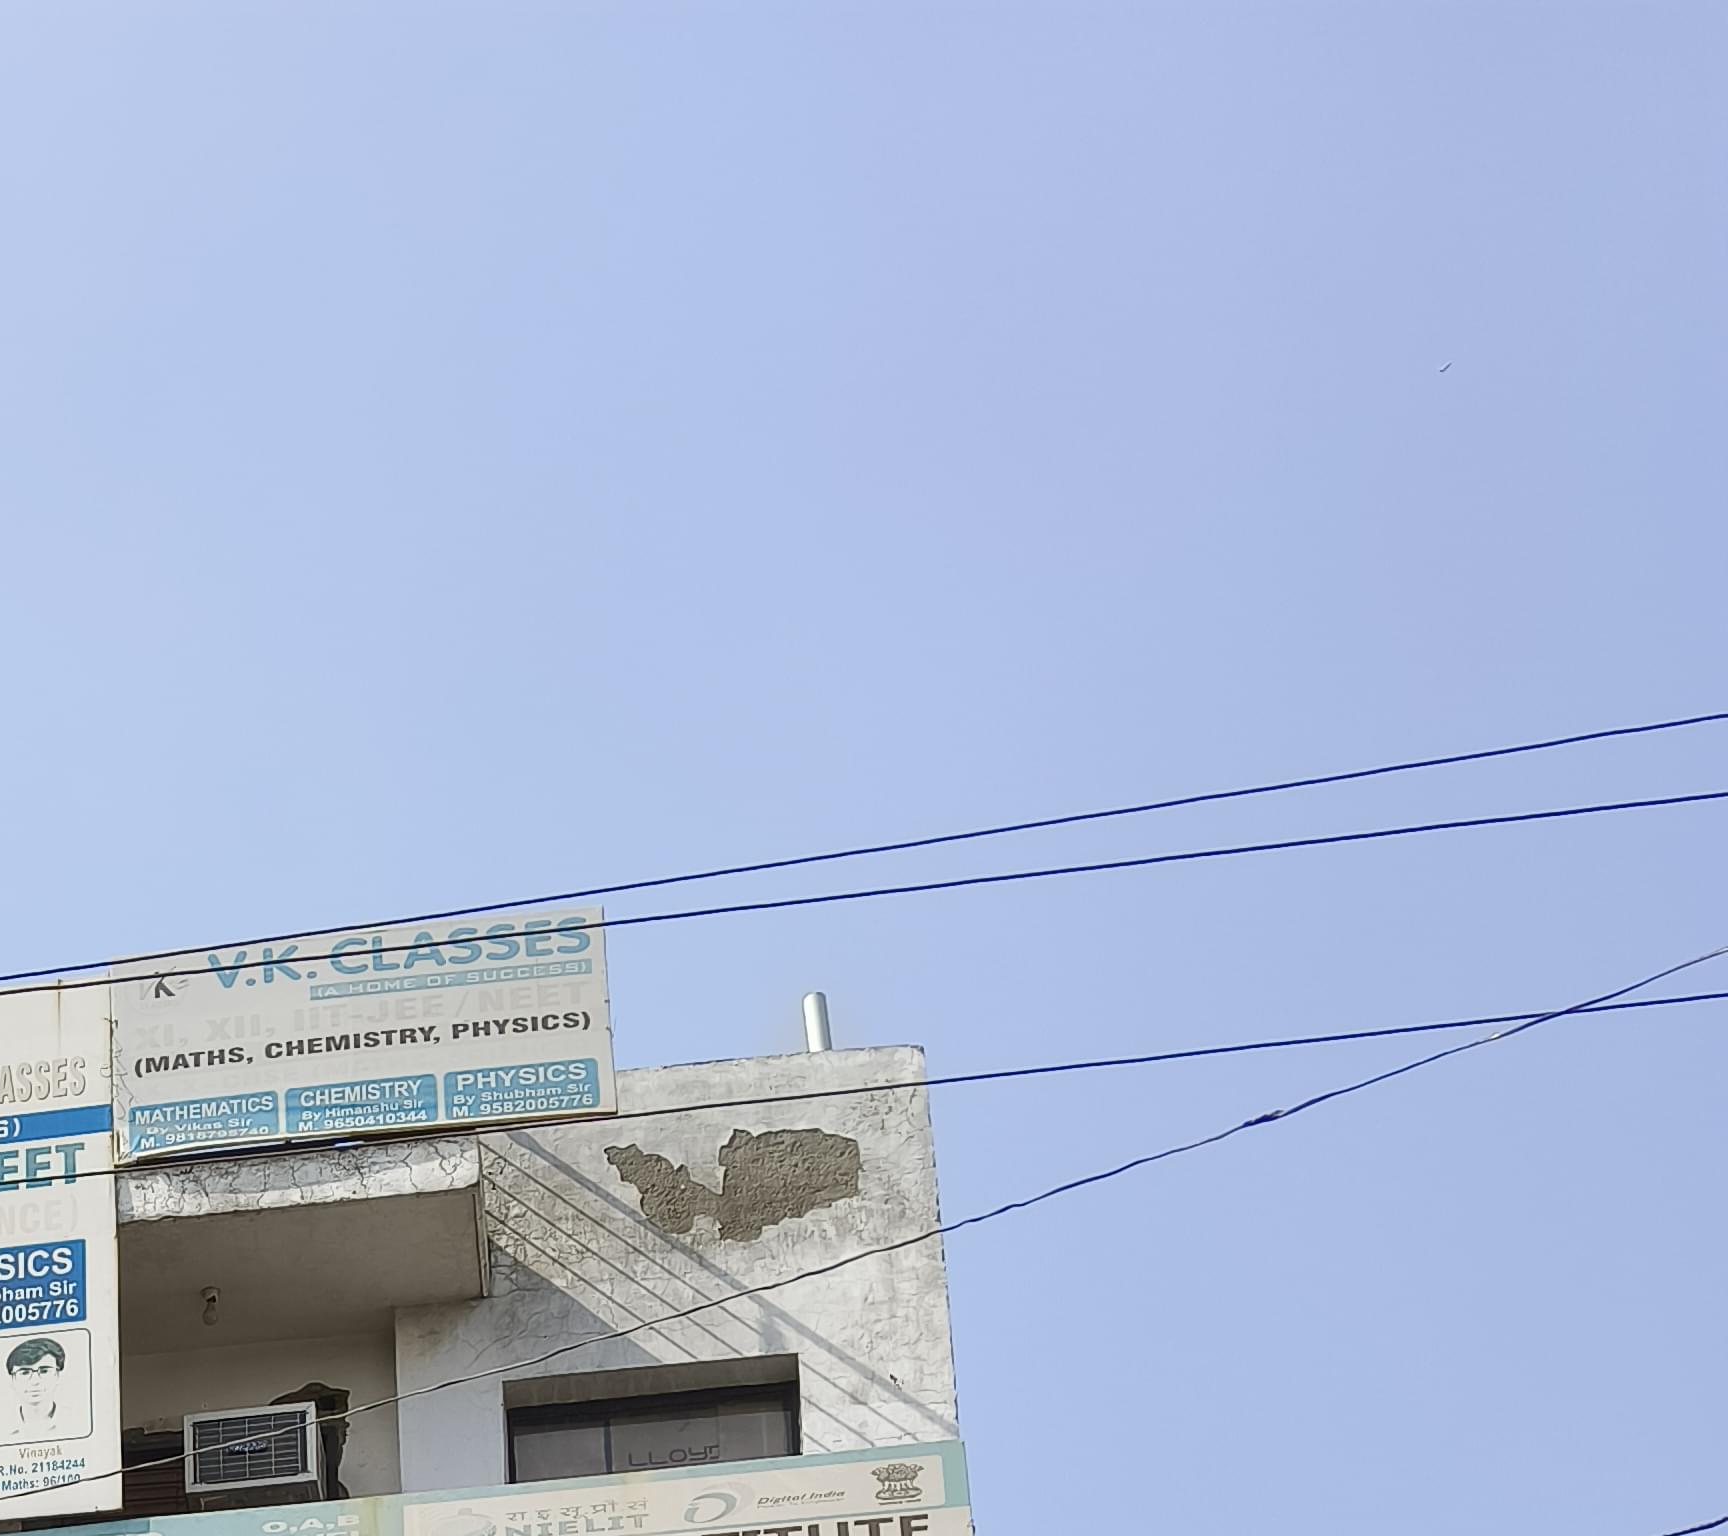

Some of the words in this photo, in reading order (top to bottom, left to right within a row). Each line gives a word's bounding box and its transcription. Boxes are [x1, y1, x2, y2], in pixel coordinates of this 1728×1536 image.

[207, 943, 317, 988] V.K.
[329, 917, 591, 975] CLASSES
[134, 1044, 253, 1077] (MATHS,
[265, 1024, 440, 1059] CHEMISTRY,
[451, 1011, 591, 1040] PHYSICS)
[53, 1280, 77, 1297] Sir
